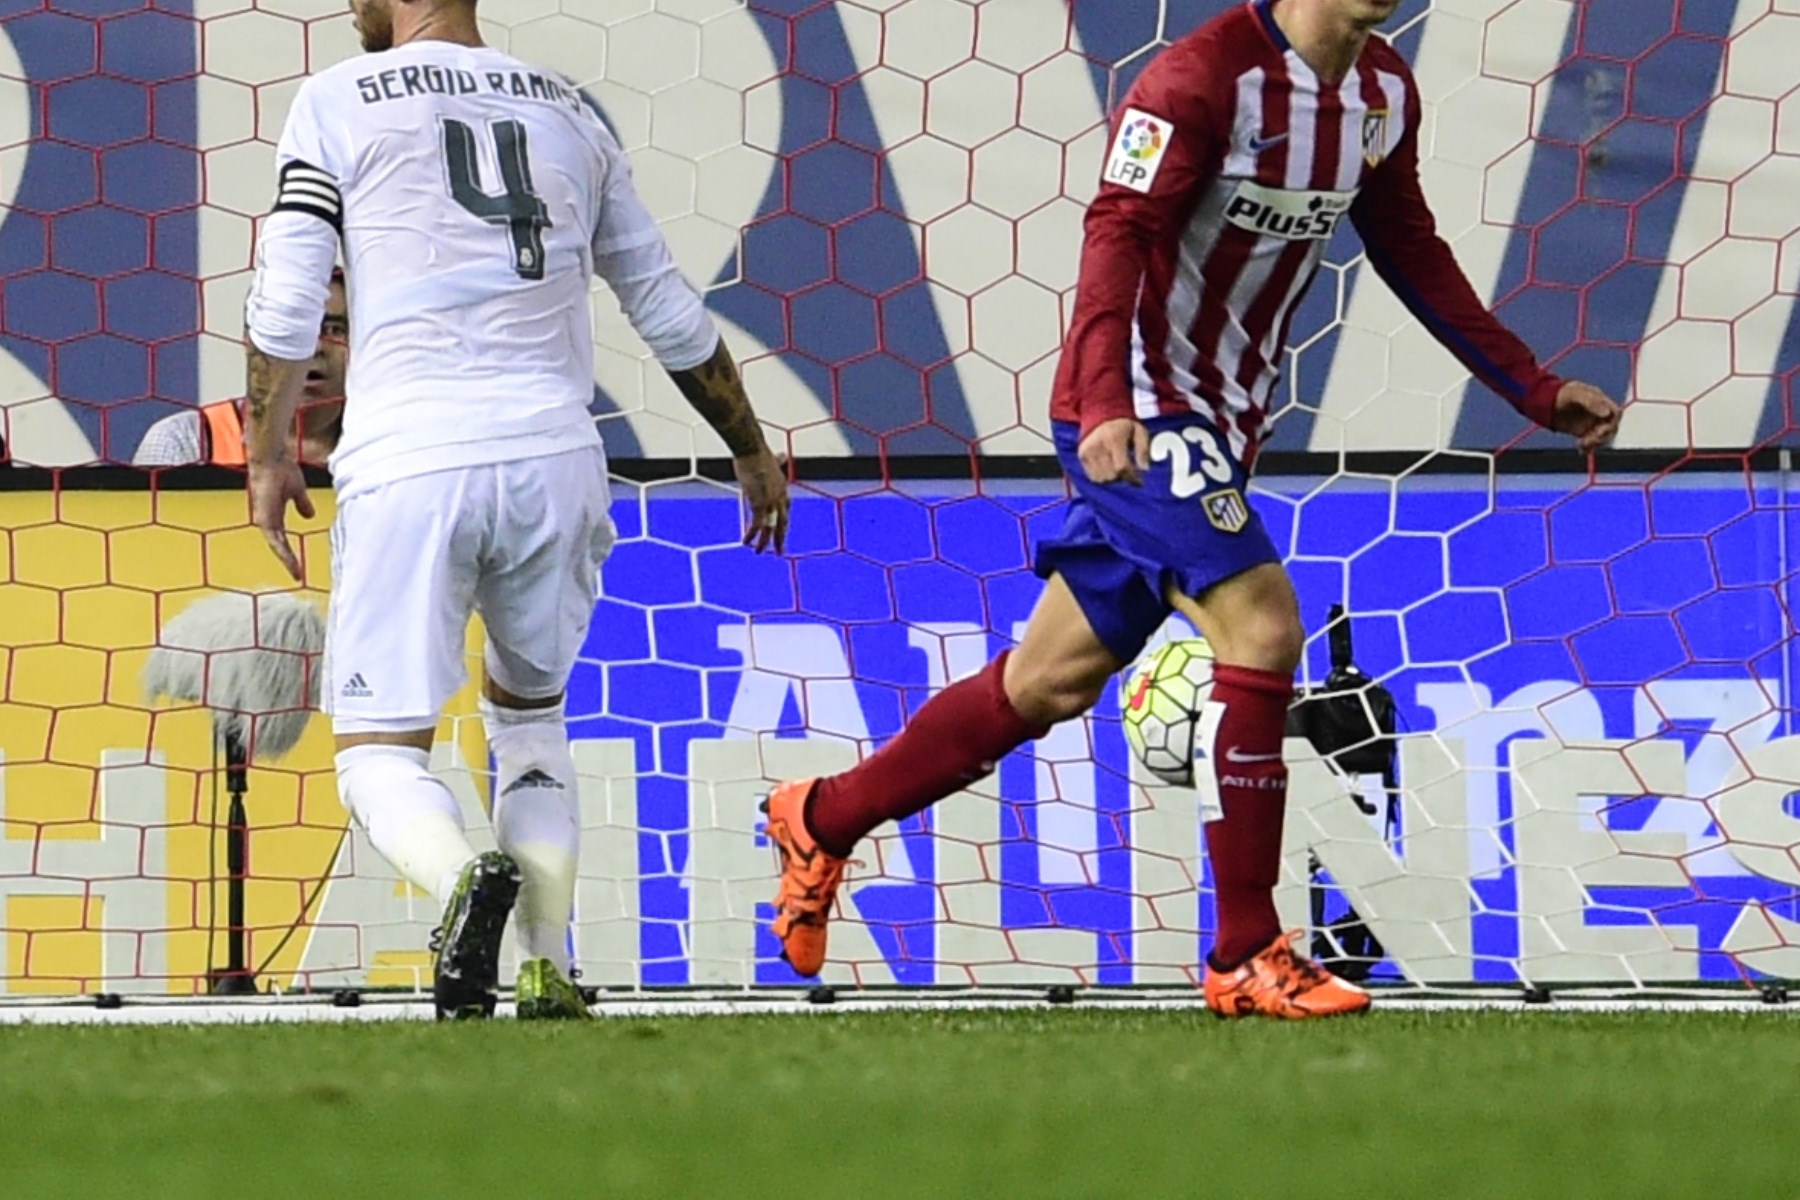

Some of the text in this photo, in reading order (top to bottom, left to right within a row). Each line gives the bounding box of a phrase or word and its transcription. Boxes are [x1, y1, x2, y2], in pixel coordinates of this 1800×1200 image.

[356, 64, 478, 104] SERGIO
[1109, 158, 1148, 185] LFP
[437, 113, 554, 281] 4
[1226, 195, 1337, 237] Plus5
[1150, 426, 1233, 498] 23
